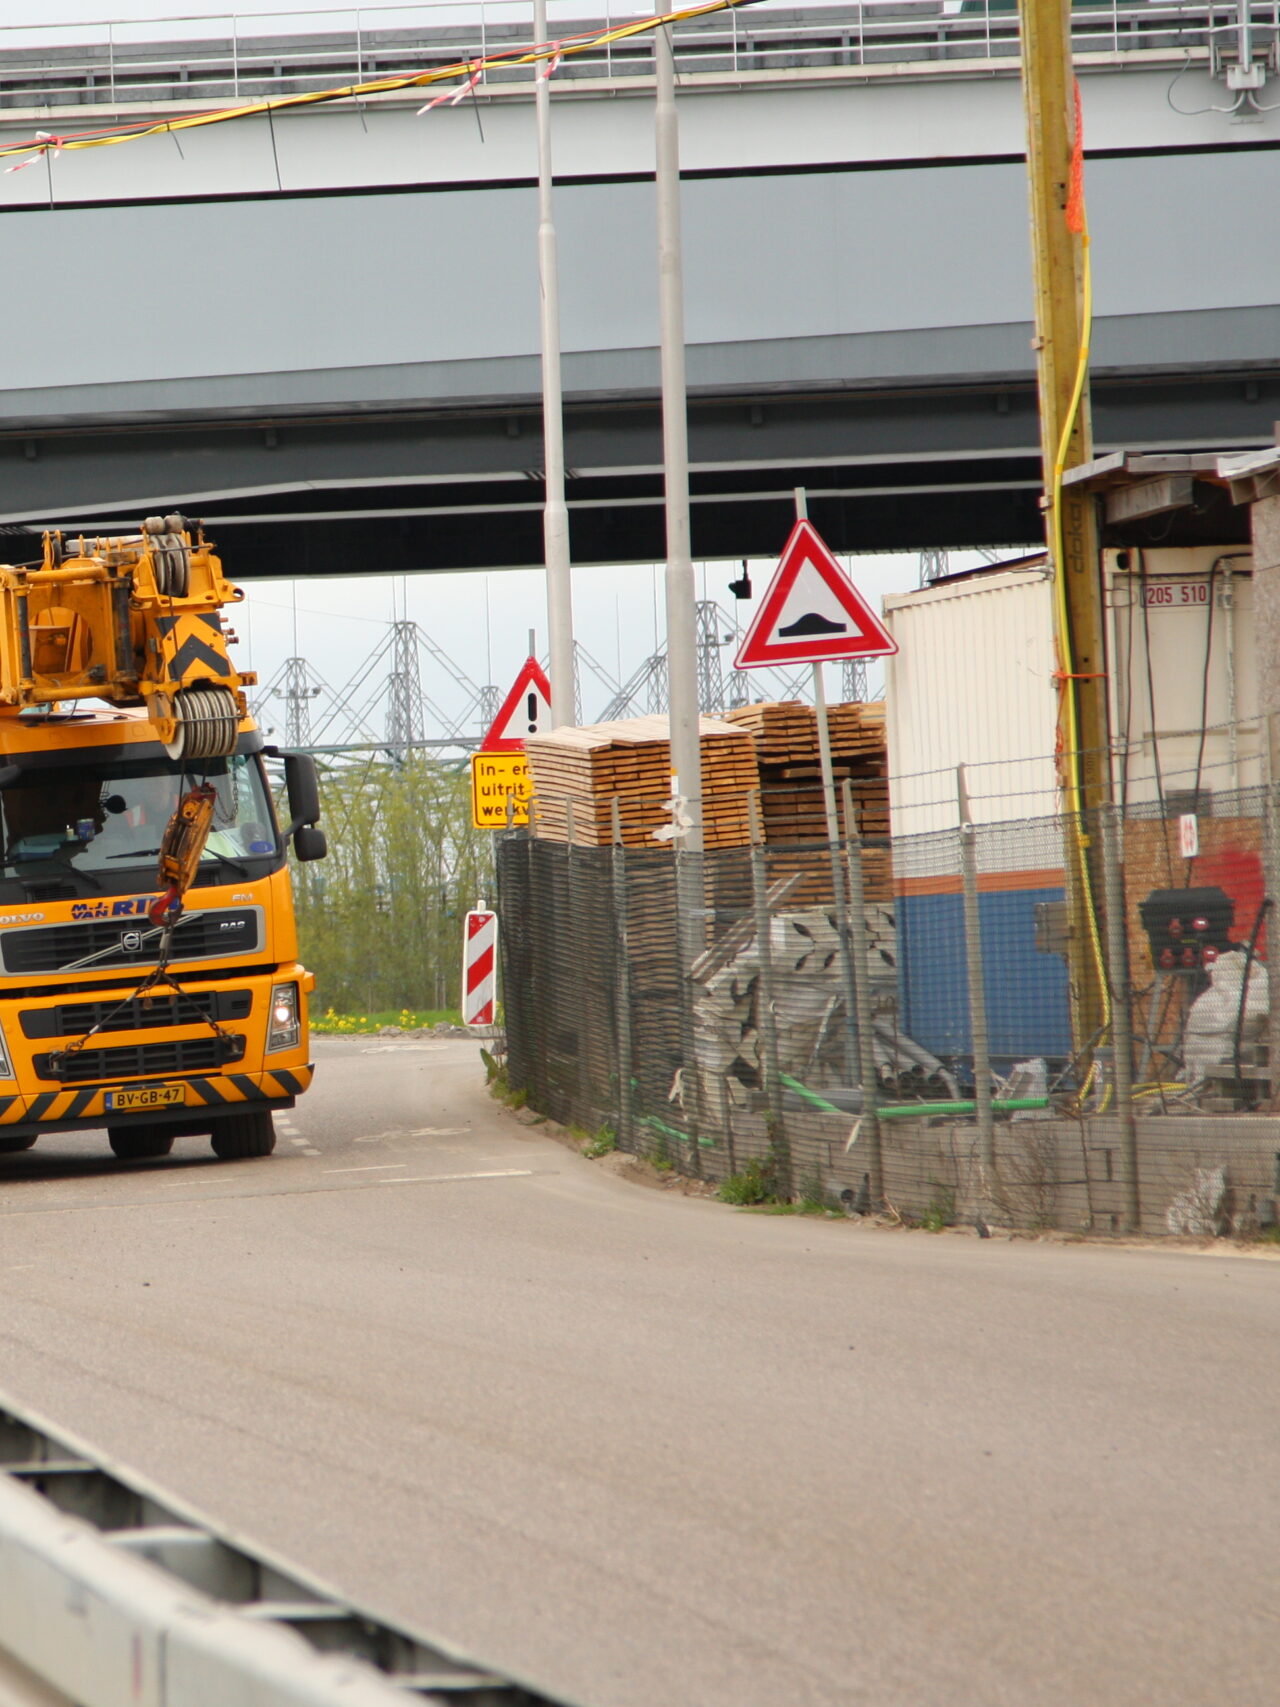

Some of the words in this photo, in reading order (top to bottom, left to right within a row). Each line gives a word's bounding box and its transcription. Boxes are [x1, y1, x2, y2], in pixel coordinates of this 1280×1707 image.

[1147, 587, 1173, 604] 205
[1181, 585, 1207, 602] 510
[480, 763, 505, 776] in-
[481, 783, 525, 796] uitrit
[232, 893, 254, 902] FM
[72, 902, 109, 912] M.J.
[72, 911, 108, 919] VAN
[117, 1089, 180, 1106] BV-GB-47
